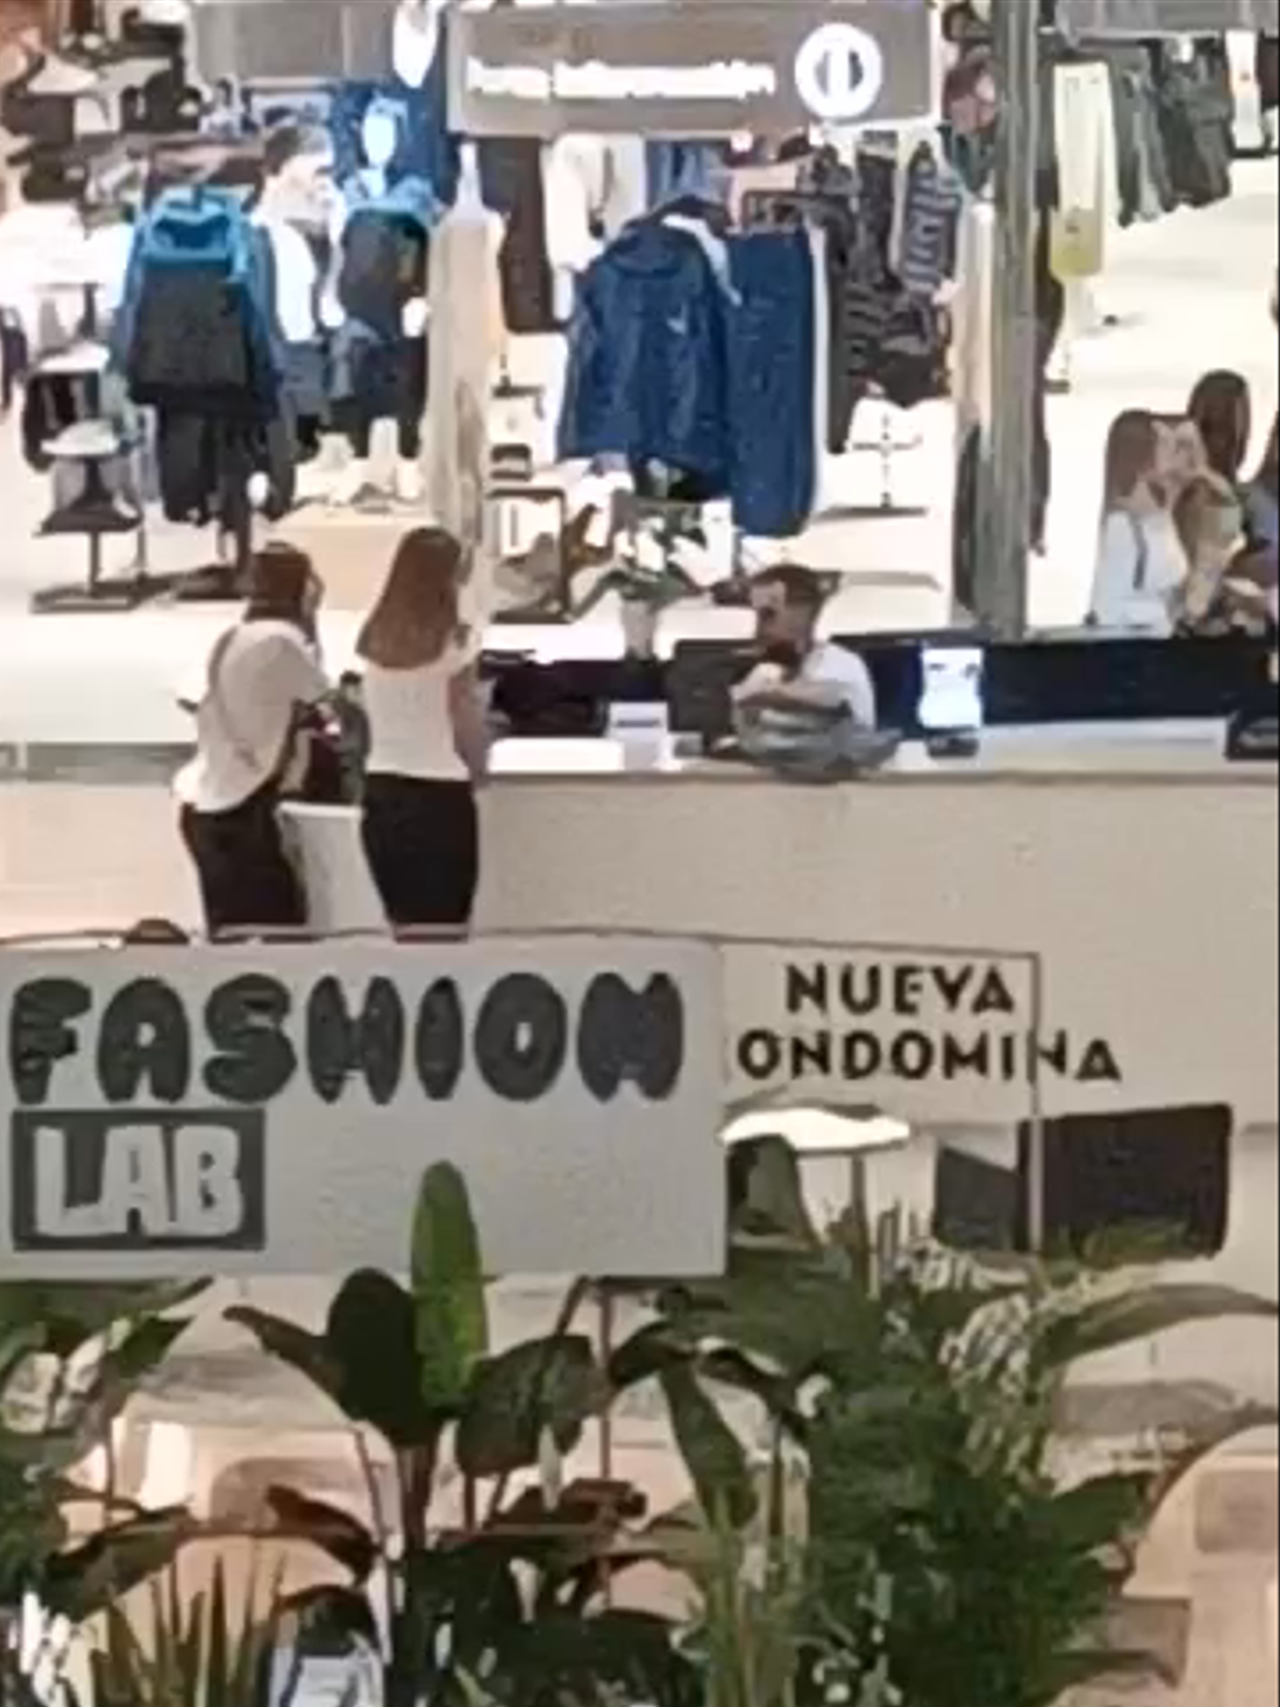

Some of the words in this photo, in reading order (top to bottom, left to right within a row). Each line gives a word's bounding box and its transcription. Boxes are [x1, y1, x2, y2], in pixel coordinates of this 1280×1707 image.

[785, 963, 1015, 1015] NUEVA
[10, 973, 684, 1105] FASHION
[737, 1029, 1122, 1081] ONDOMINA
[33, 1124, 244, 1237] LAB
